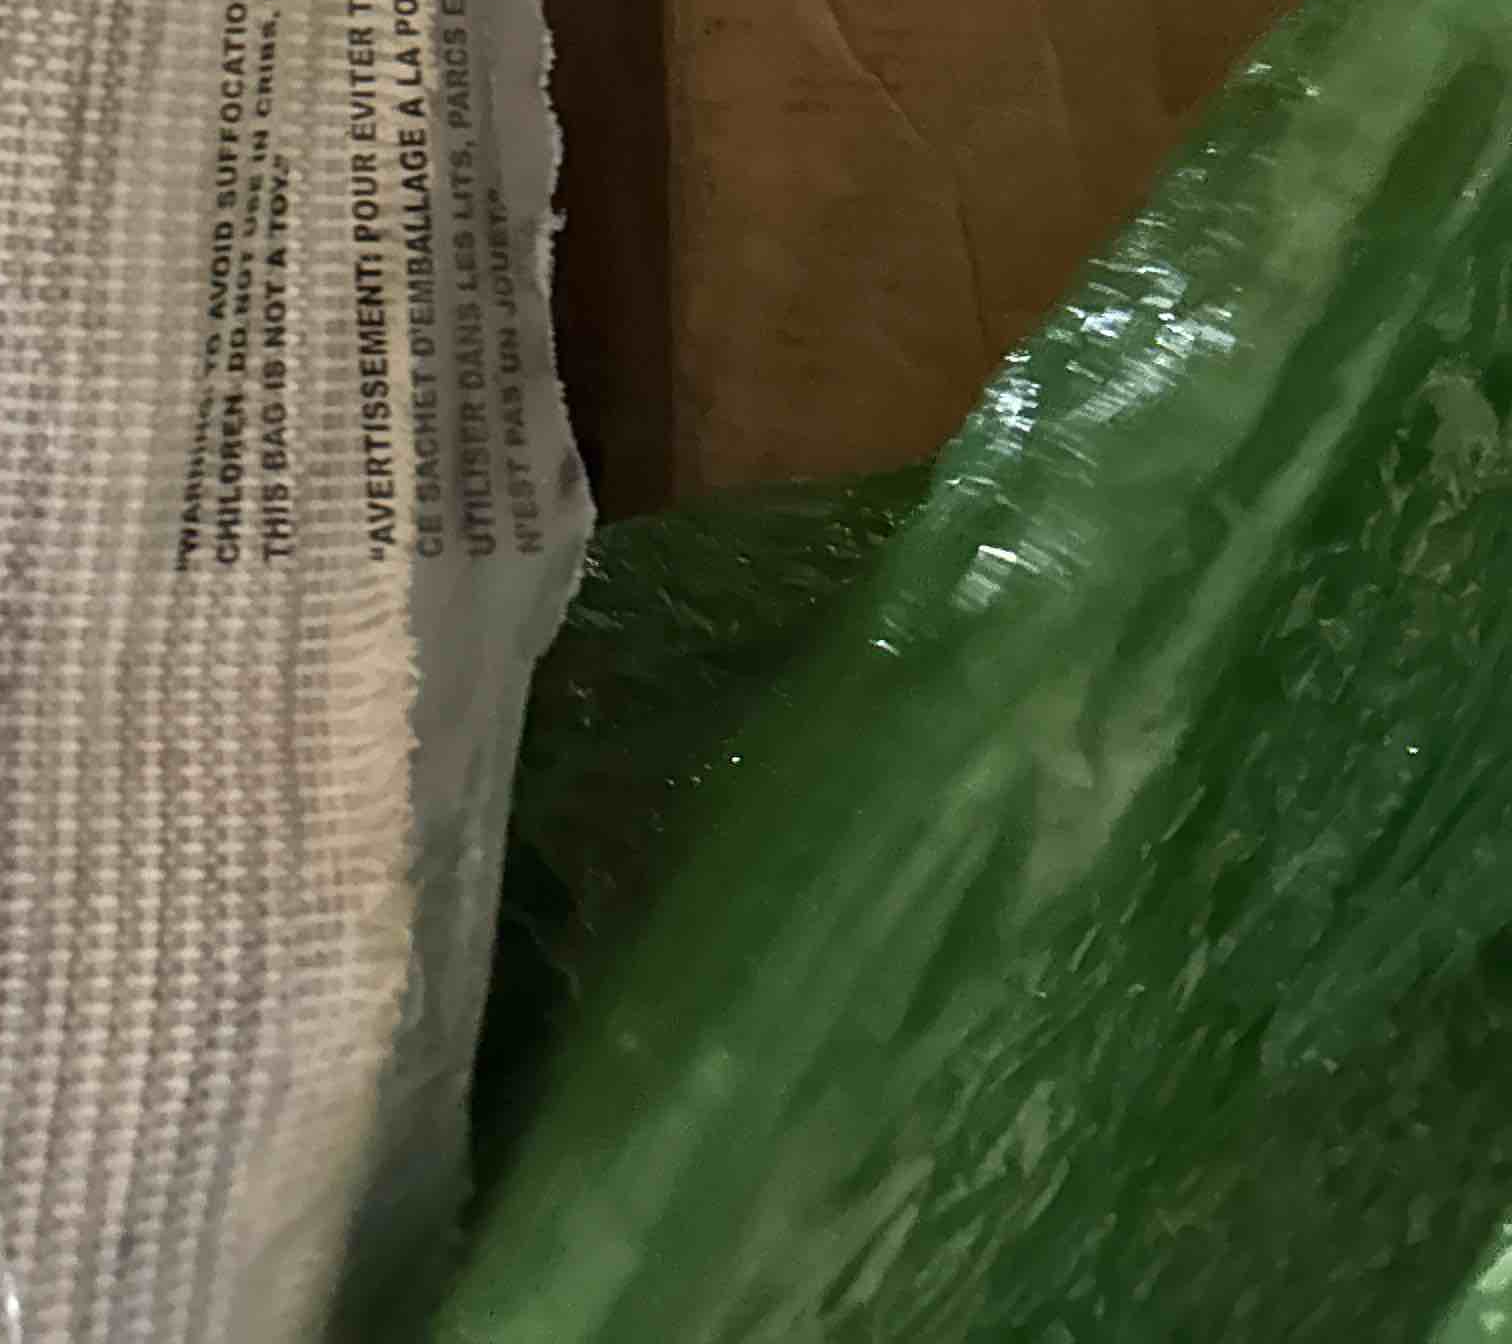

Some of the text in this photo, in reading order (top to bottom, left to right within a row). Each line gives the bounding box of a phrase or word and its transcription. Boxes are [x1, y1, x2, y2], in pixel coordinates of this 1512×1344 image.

[394, 46, 423, 86] LA
[439, 27, 473, 129] PARCS
[251, 129, 270, 162] IN
[243, 175, 263, 238] USE
[350, 152, 380, 243] POUR
[207, 220, 235, 320] AVOID
[265, 247, 287, 269] A
[397, 127, 436, 358] D'EMBALLAGE
[450, 230, 478, 291] LES
[236, 250, 255, 315] NOT
[263, 280, 287, 348] NOT
[202, 333, 221, 377] TO
[228, 326, 247, 373] DO
[262, 359, 287, 391] IS
[455, 302, 486, 391] DANS
[497, 327, 521, 375] UN
[261, 401, 287, 471] BAG
[409, 368, 441, 504] SACHET
[498, 385, 527, 448] PAS
[457, 401, 496, 557] UTILISER
[506, 456, 544, 555] N'EST
[260, 483, 293, 562] THIS
[414, 514, 443, 559] CE
